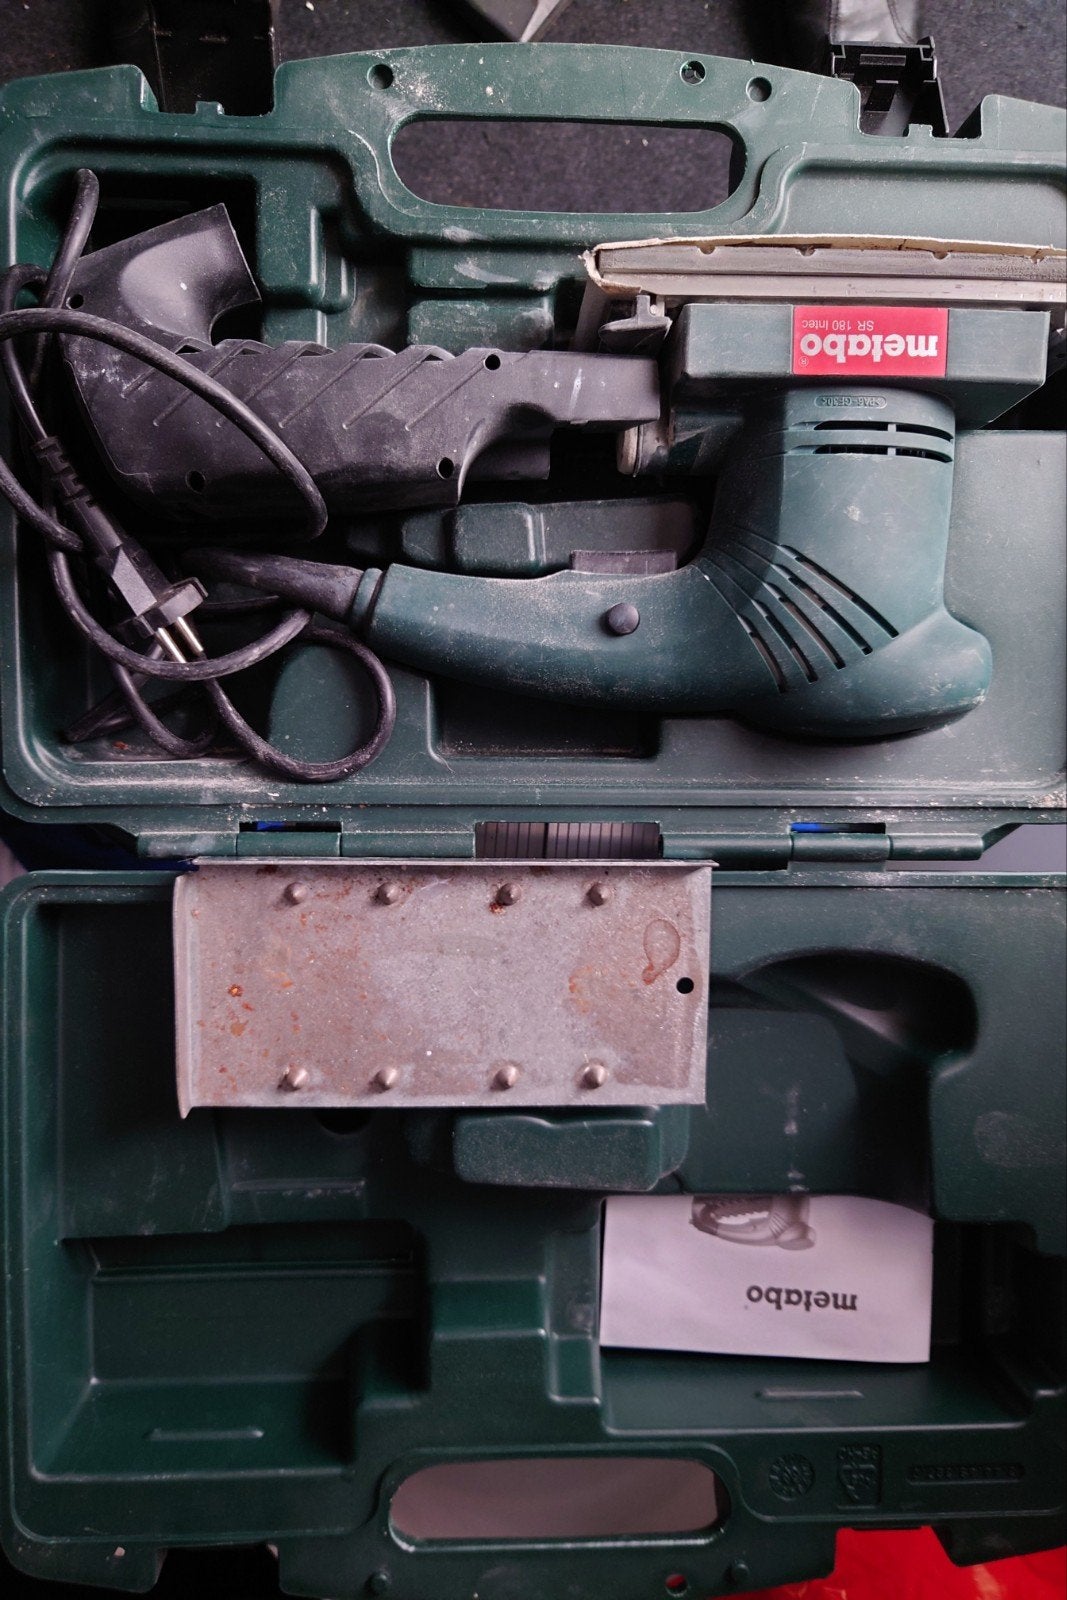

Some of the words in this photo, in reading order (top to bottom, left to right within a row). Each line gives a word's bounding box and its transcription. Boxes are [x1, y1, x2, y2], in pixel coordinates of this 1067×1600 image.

[802, 319, 829, 331] Intec
[832, 320, 851, 331] 180
[857, 320, 874, 331] SR
[800, 333, 938, 364] metabo
[746, 1285, 858, 1312] metabo
